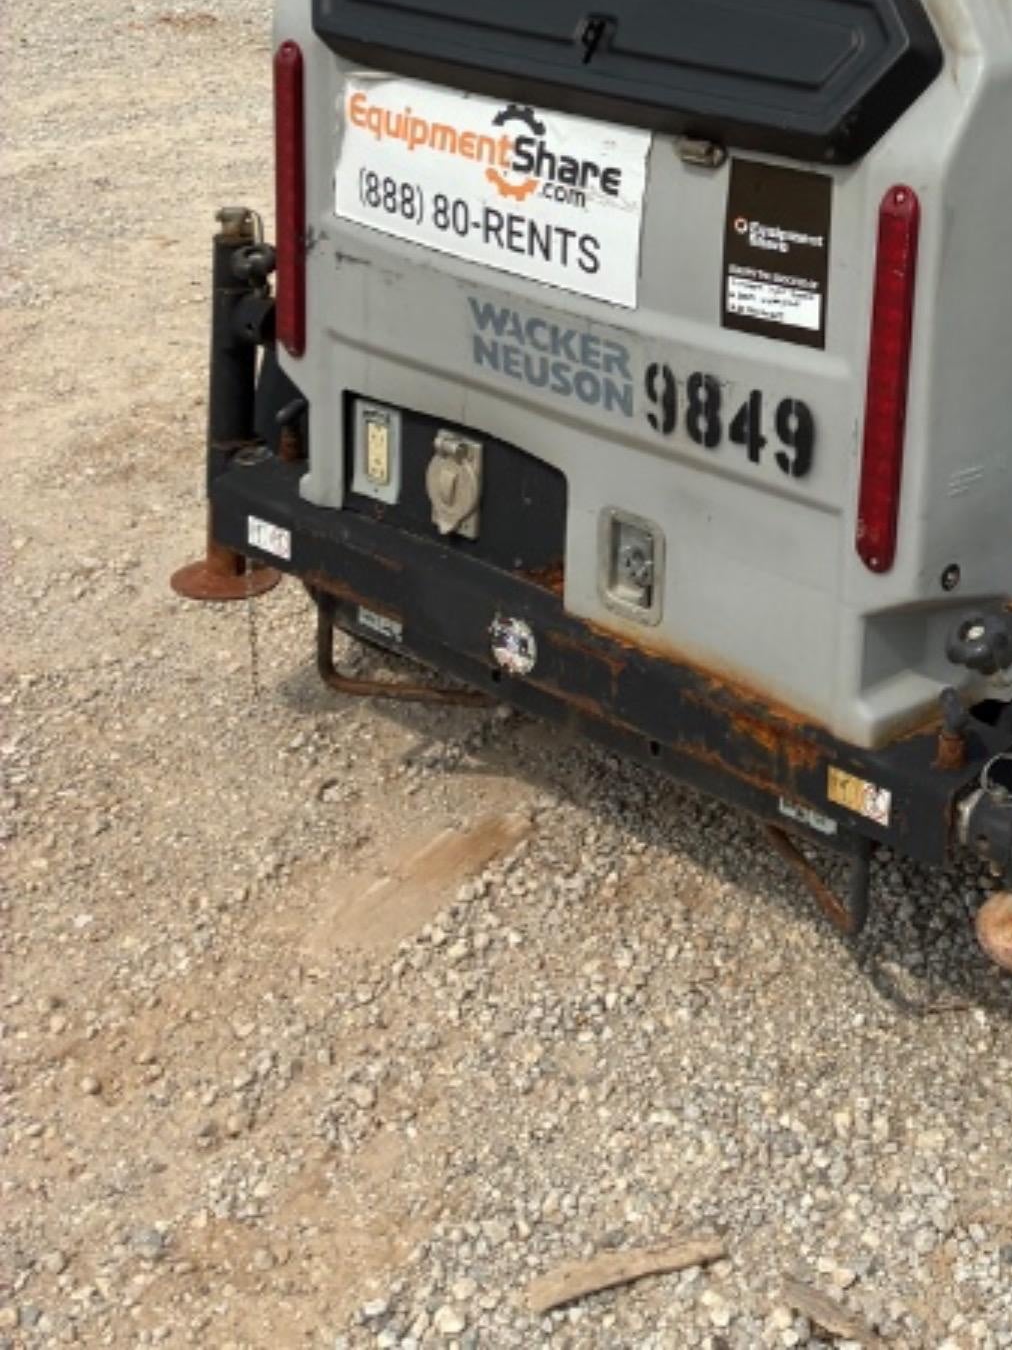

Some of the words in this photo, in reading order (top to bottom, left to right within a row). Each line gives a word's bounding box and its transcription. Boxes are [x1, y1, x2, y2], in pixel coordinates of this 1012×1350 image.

[349, 93, 622, 197] EquipmentShare
[360, 166, 424, 226] (888)
[433, 193, 602, 275] 80-RENTS
[468, 297, 633, 380] WACKER
[473, 335, 634, 417] NEUSON
[644, 361, 816, 479] 9849
